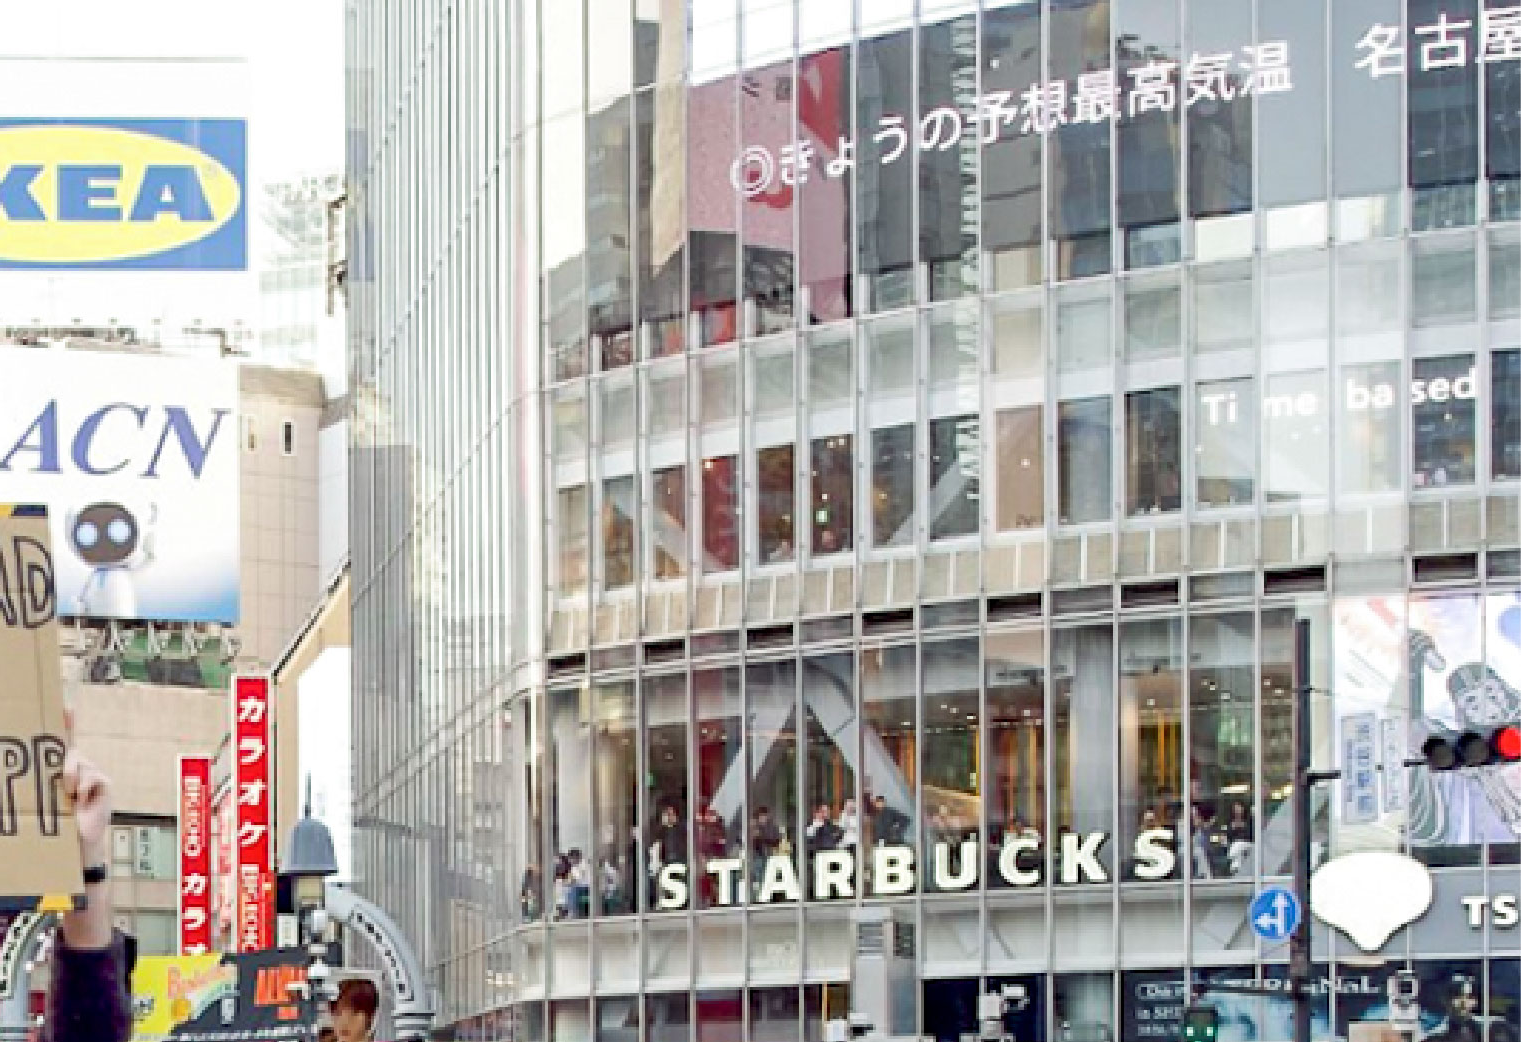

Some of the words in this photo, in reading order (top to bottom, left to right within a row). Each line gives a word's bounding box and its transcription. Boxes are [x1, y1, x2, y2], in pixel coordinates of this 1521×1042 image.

[1353, 7, 1521, 79] 名古屋
[237, 694, 267, 847] カラオケ
[656, 827, 1177, 909] STARBUCKS
[1462, 894, 1521, 928] TS
